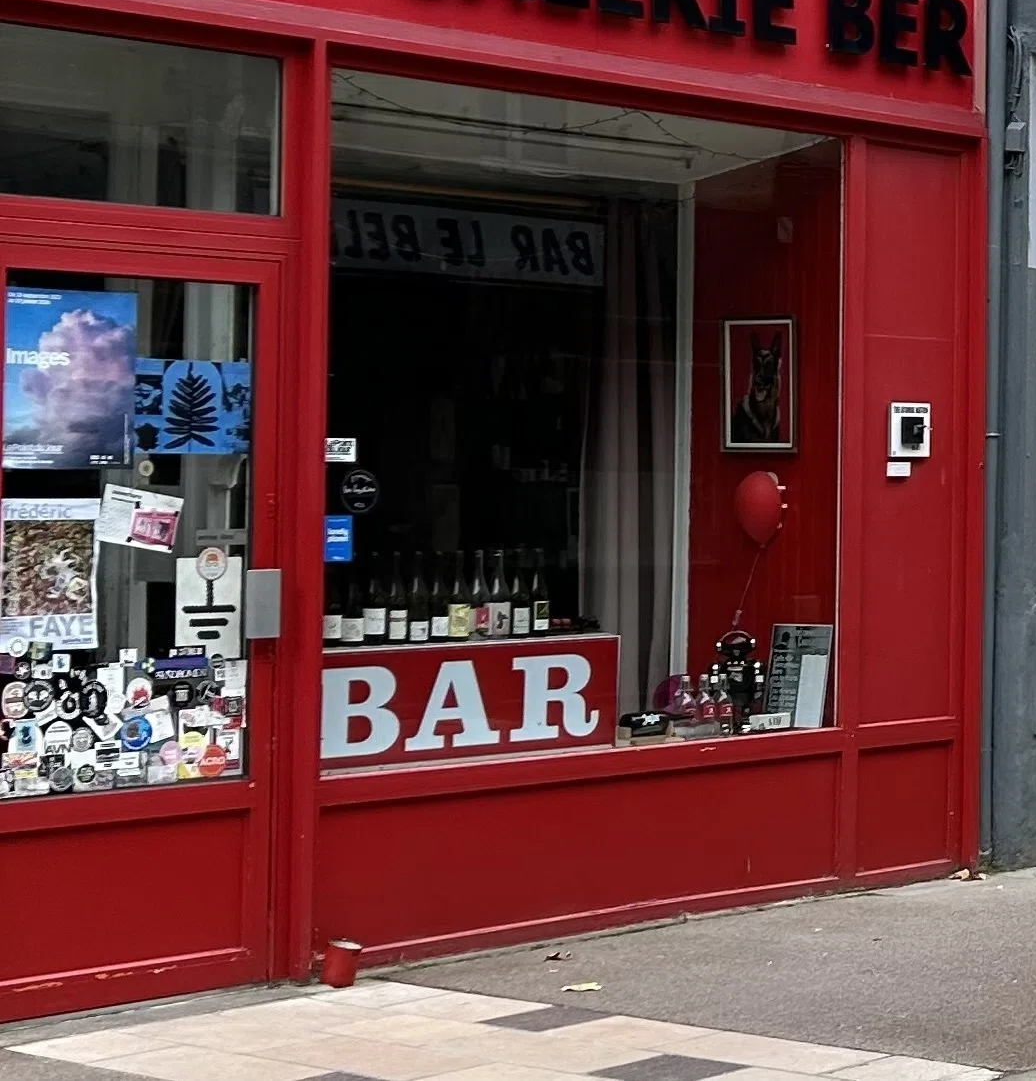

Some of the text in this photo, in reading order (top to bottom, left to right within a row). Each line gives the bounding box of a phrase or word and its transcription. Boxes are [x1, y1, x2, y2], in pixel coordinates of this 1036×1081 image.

[5, 347, 71, 370] Images
[3, 502, 73, 519] frédéric
[29, 615, 94, 637] FAYE
[320, 653, 600, 760] BAR
